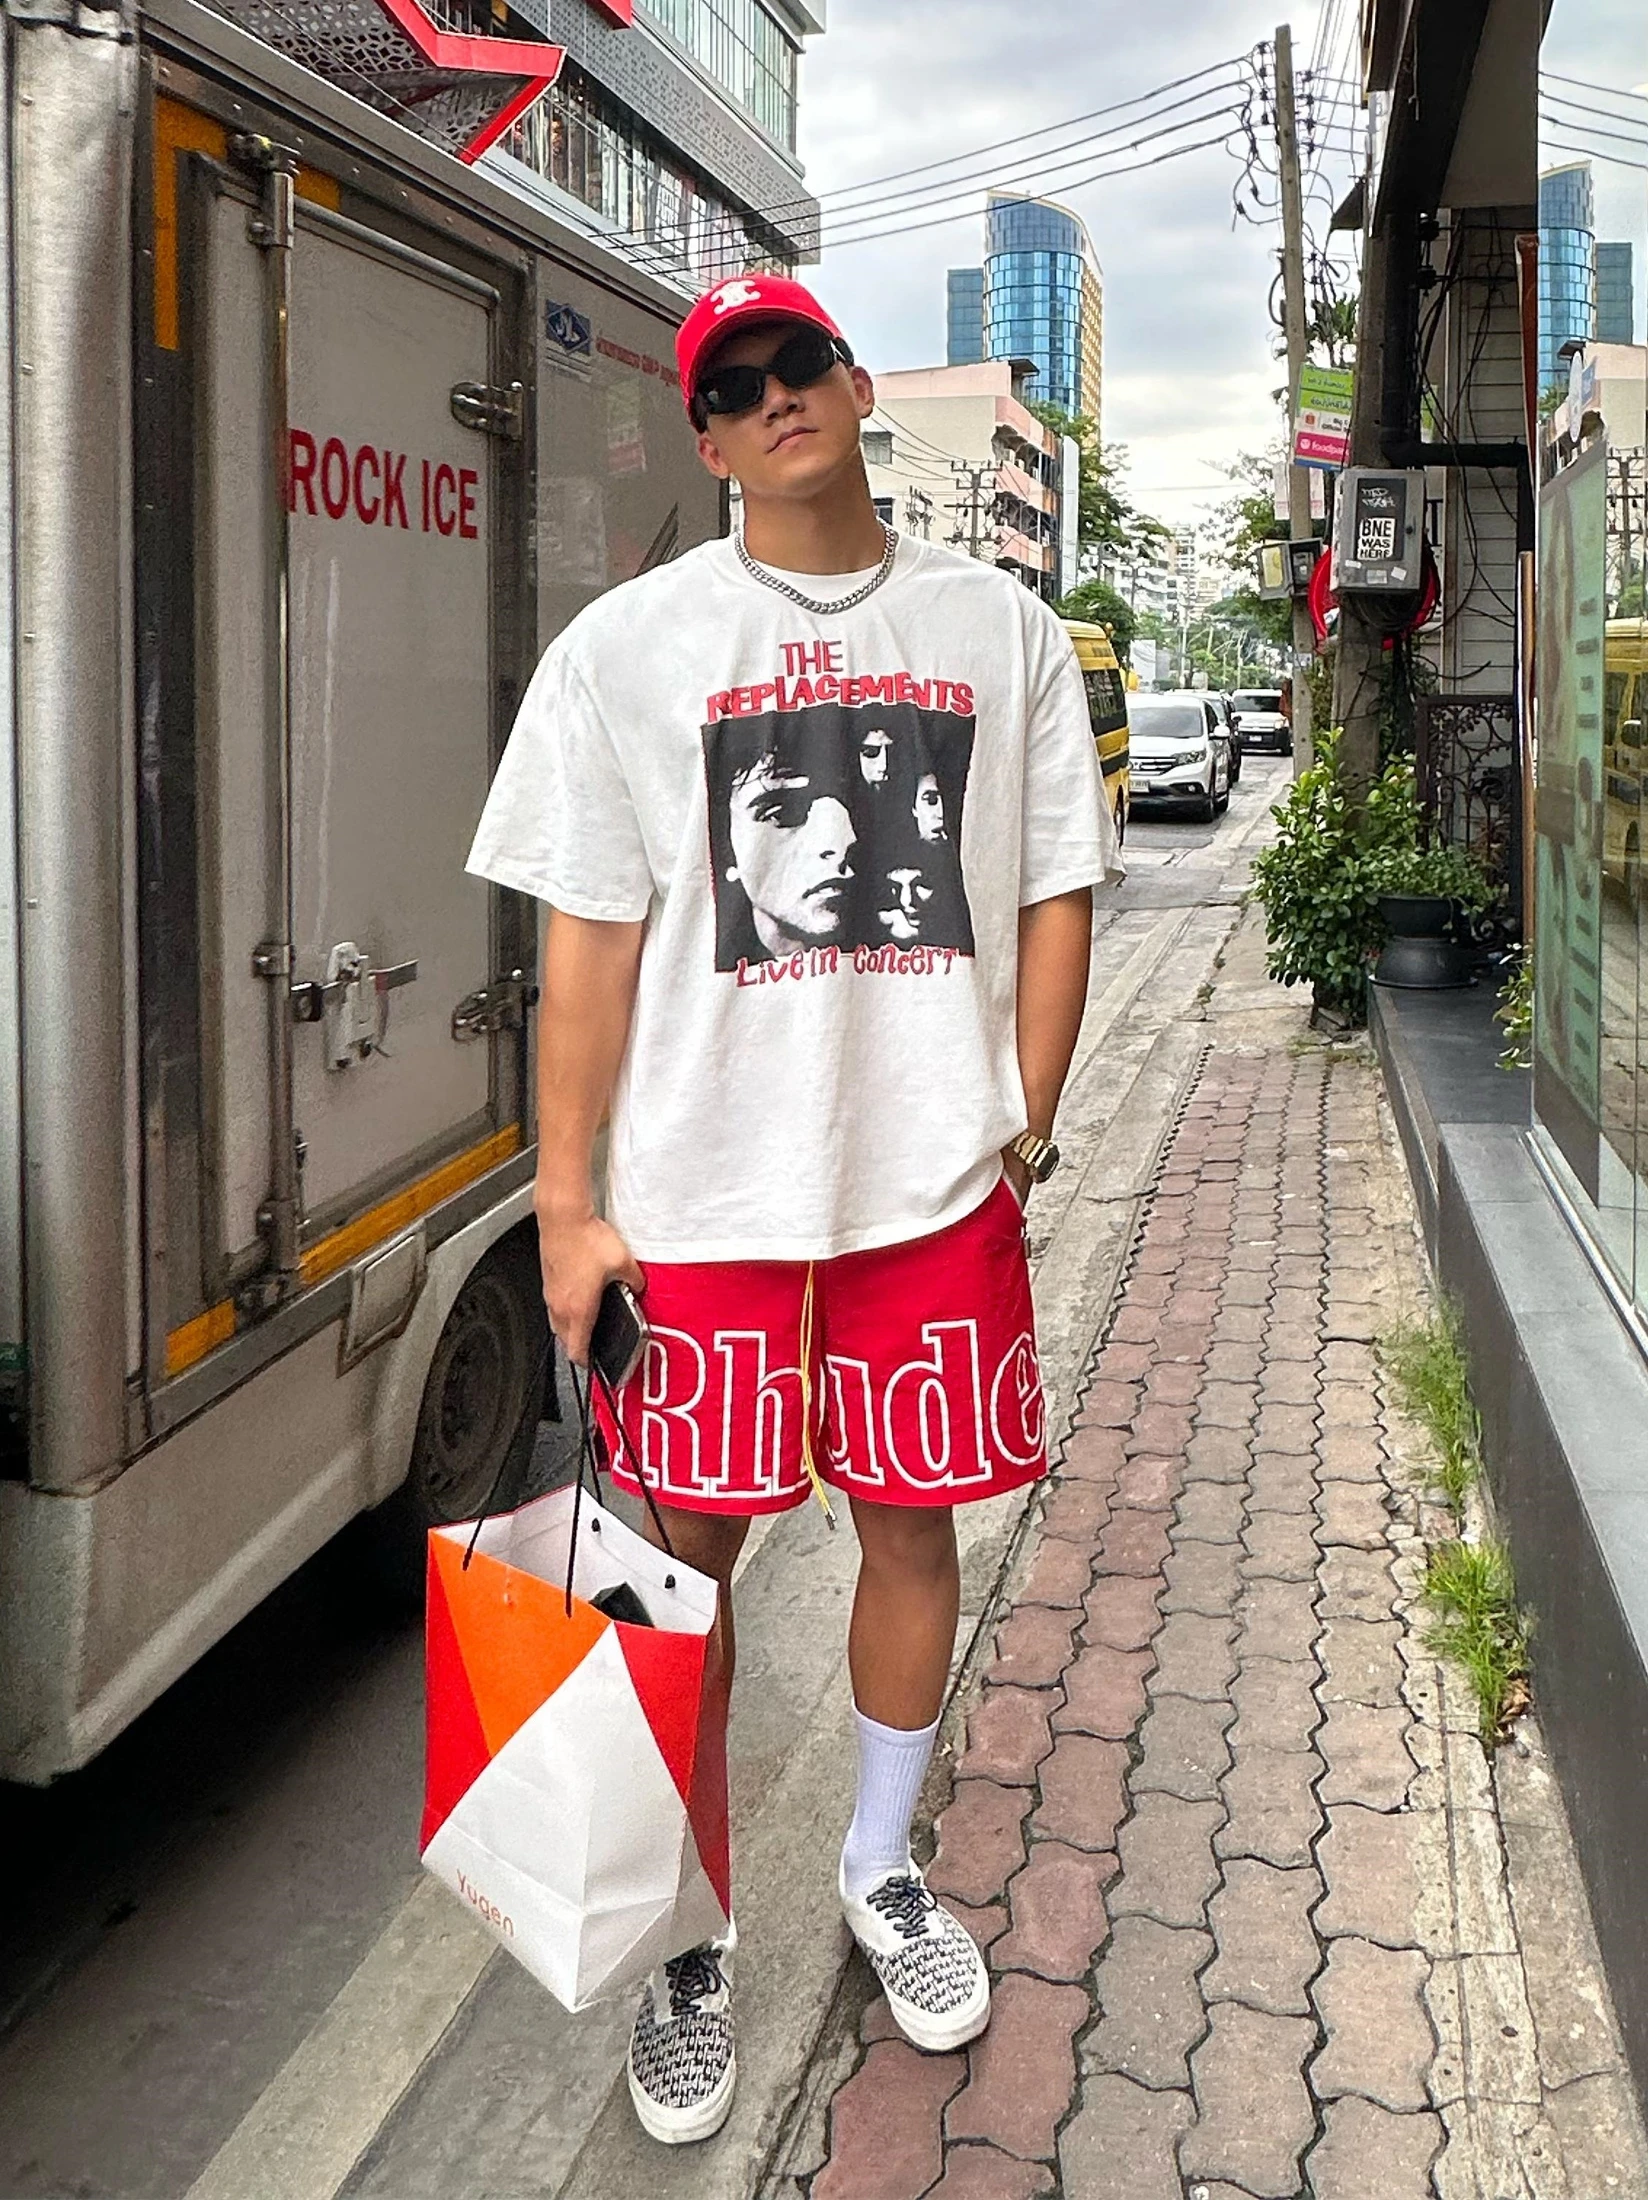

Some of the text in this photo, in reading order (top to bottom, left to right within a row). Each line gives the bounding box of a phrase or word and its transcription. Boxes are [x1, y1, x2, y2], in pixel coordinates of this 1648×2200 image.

[289, 428, 479, 539] ROCK ICE
[1361, 519, 1392, 537] BNE
[1361, 539, 1391, 548] WAS
[779, 640, 844, 675] THE
[706, 672, 975, 722] REPLACEMENTS
[612, 1318, 1046, 1498] Rhude
[456, 1868, 515, 1938] Yugen
